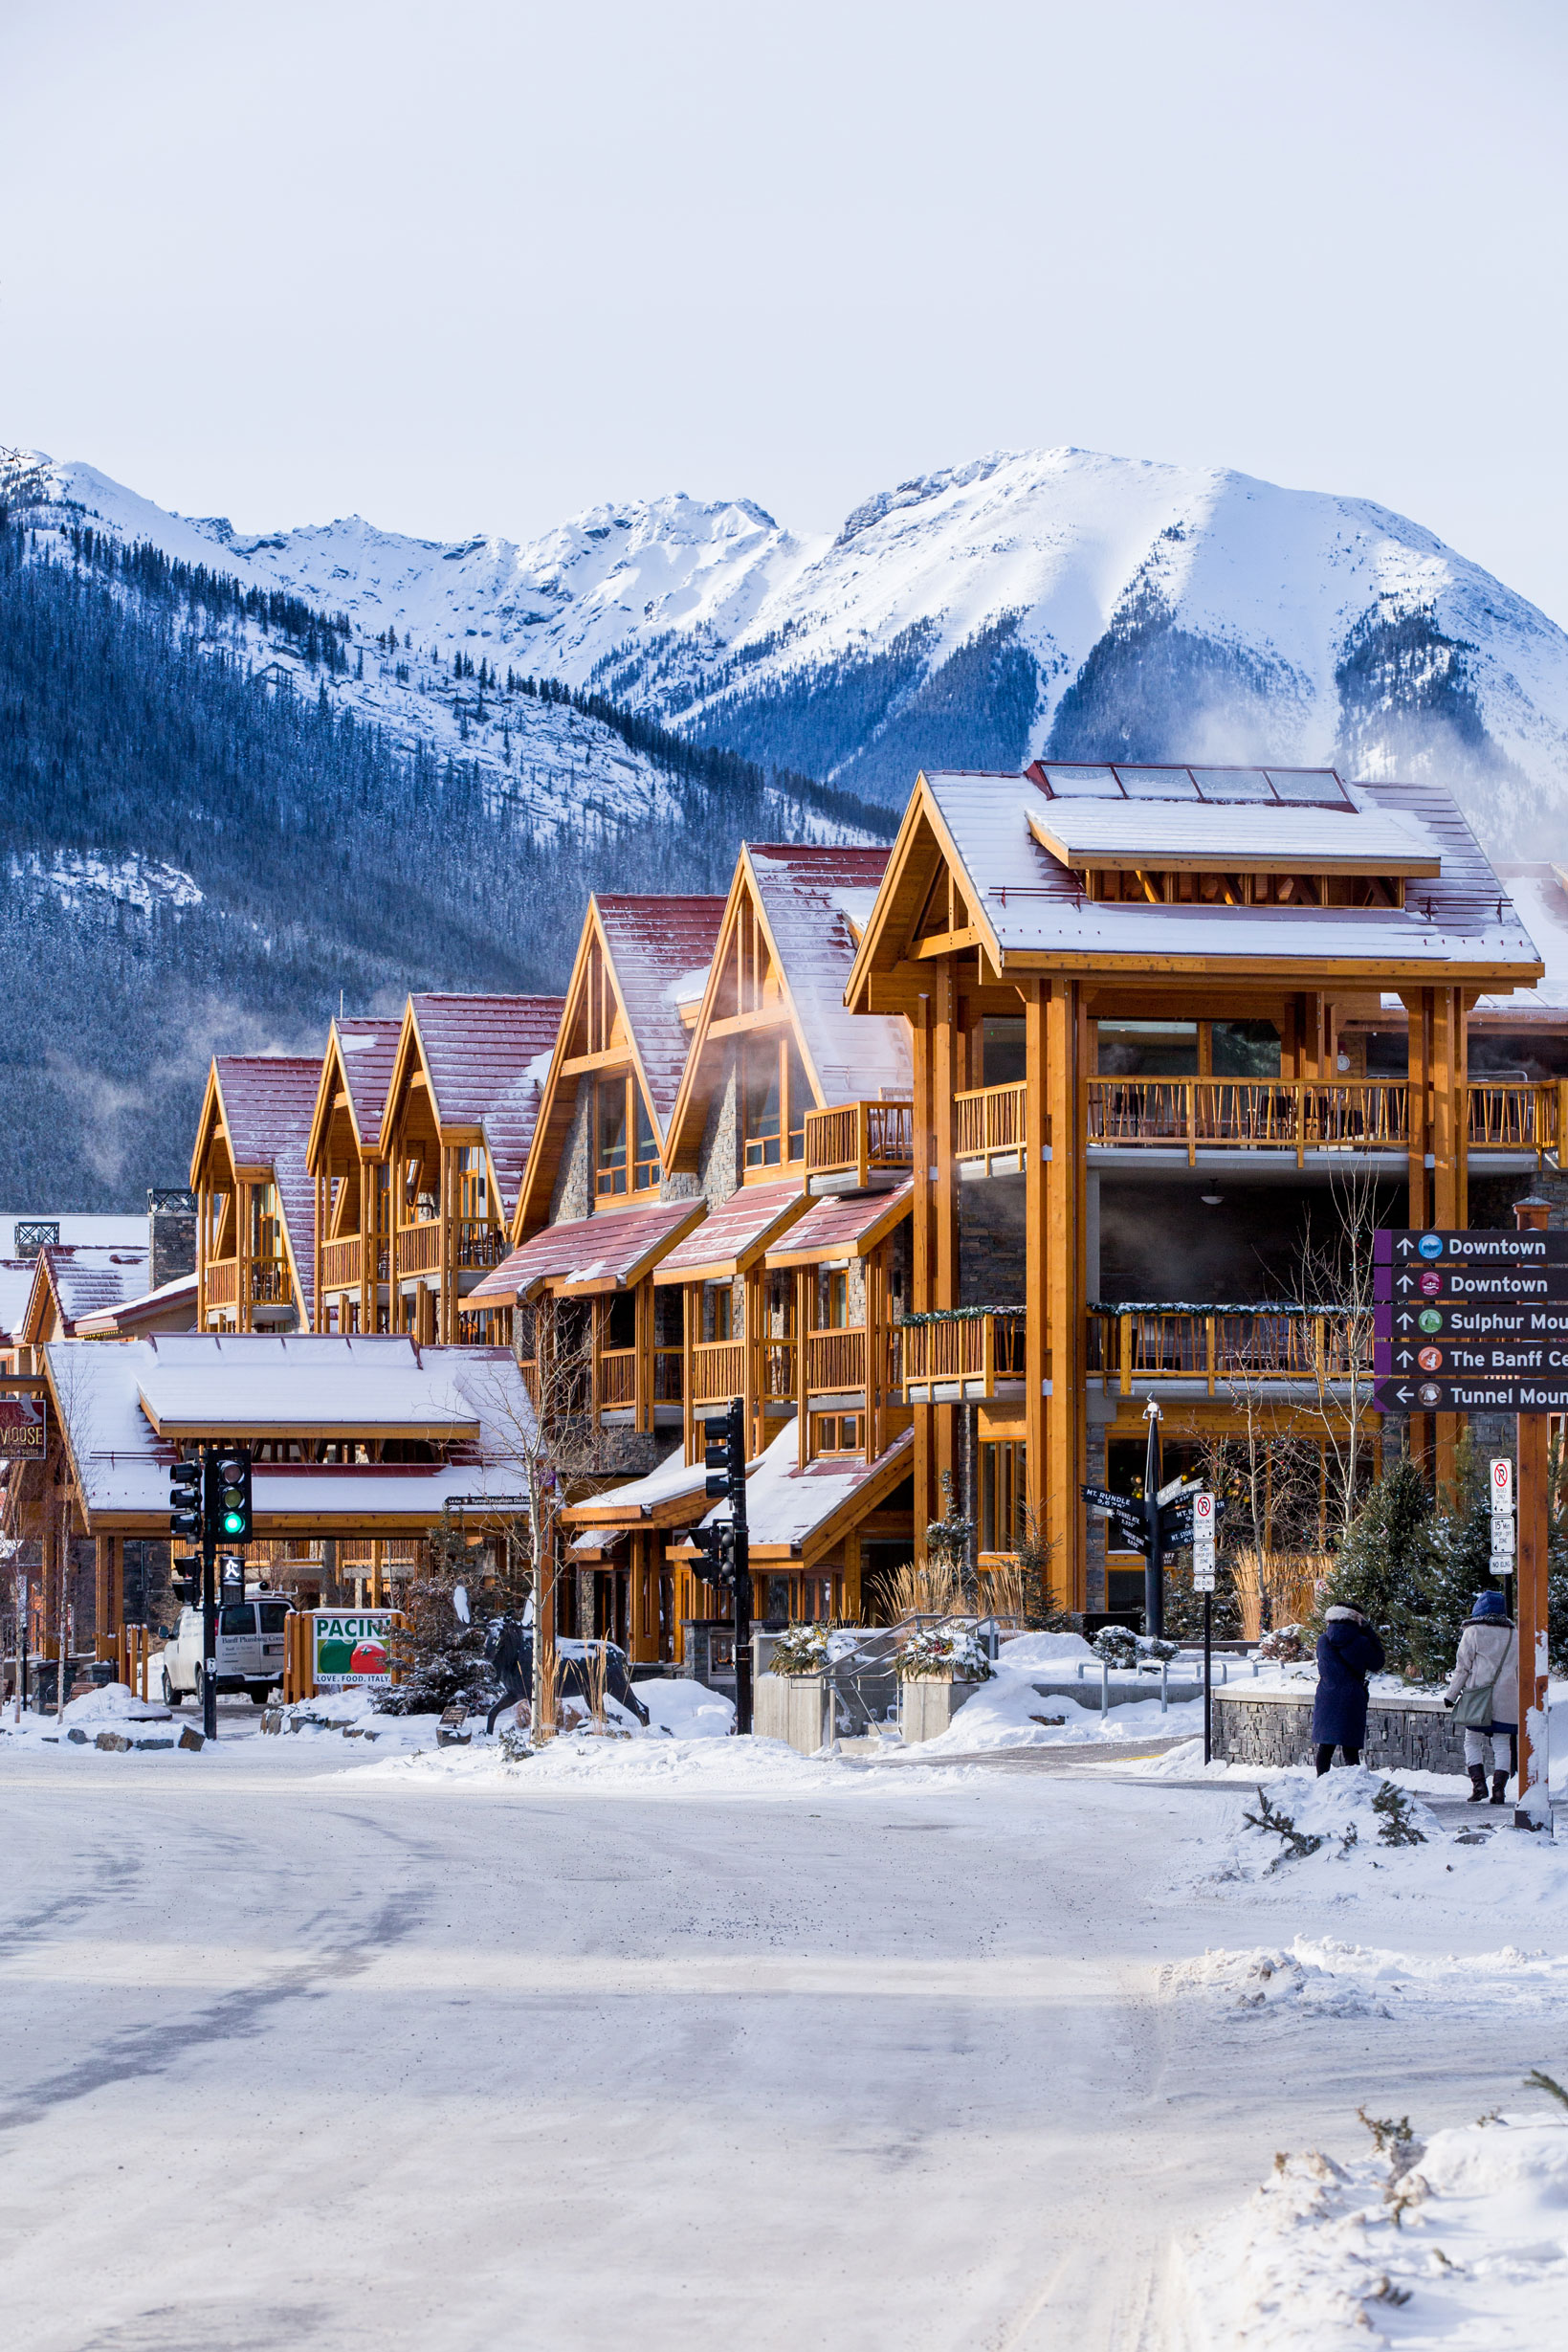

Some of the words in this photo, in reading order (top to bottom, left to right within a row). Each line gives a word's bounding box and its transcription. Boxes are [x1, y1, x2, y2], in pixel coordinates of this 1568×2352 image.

[1448, 1238, 1546, 1255] Downtown
[1450, 1276, 1548, 1293] Downtown
[1450, 1313, 1525, 1333] Sulphur
[1531, 1314, 1568, 1330] Mou
[1450, 1350, 1485, 1367] The
[1491, 1350, 1543, 1367] Banff
[1450, 1387, 1513, 1404] Tunnel
[1520, 1387, 1568, 1404] Moun
[1099, 1492, 1131, 1506] RUNDLE
[1494, 1520, 1500, 1530] 15
